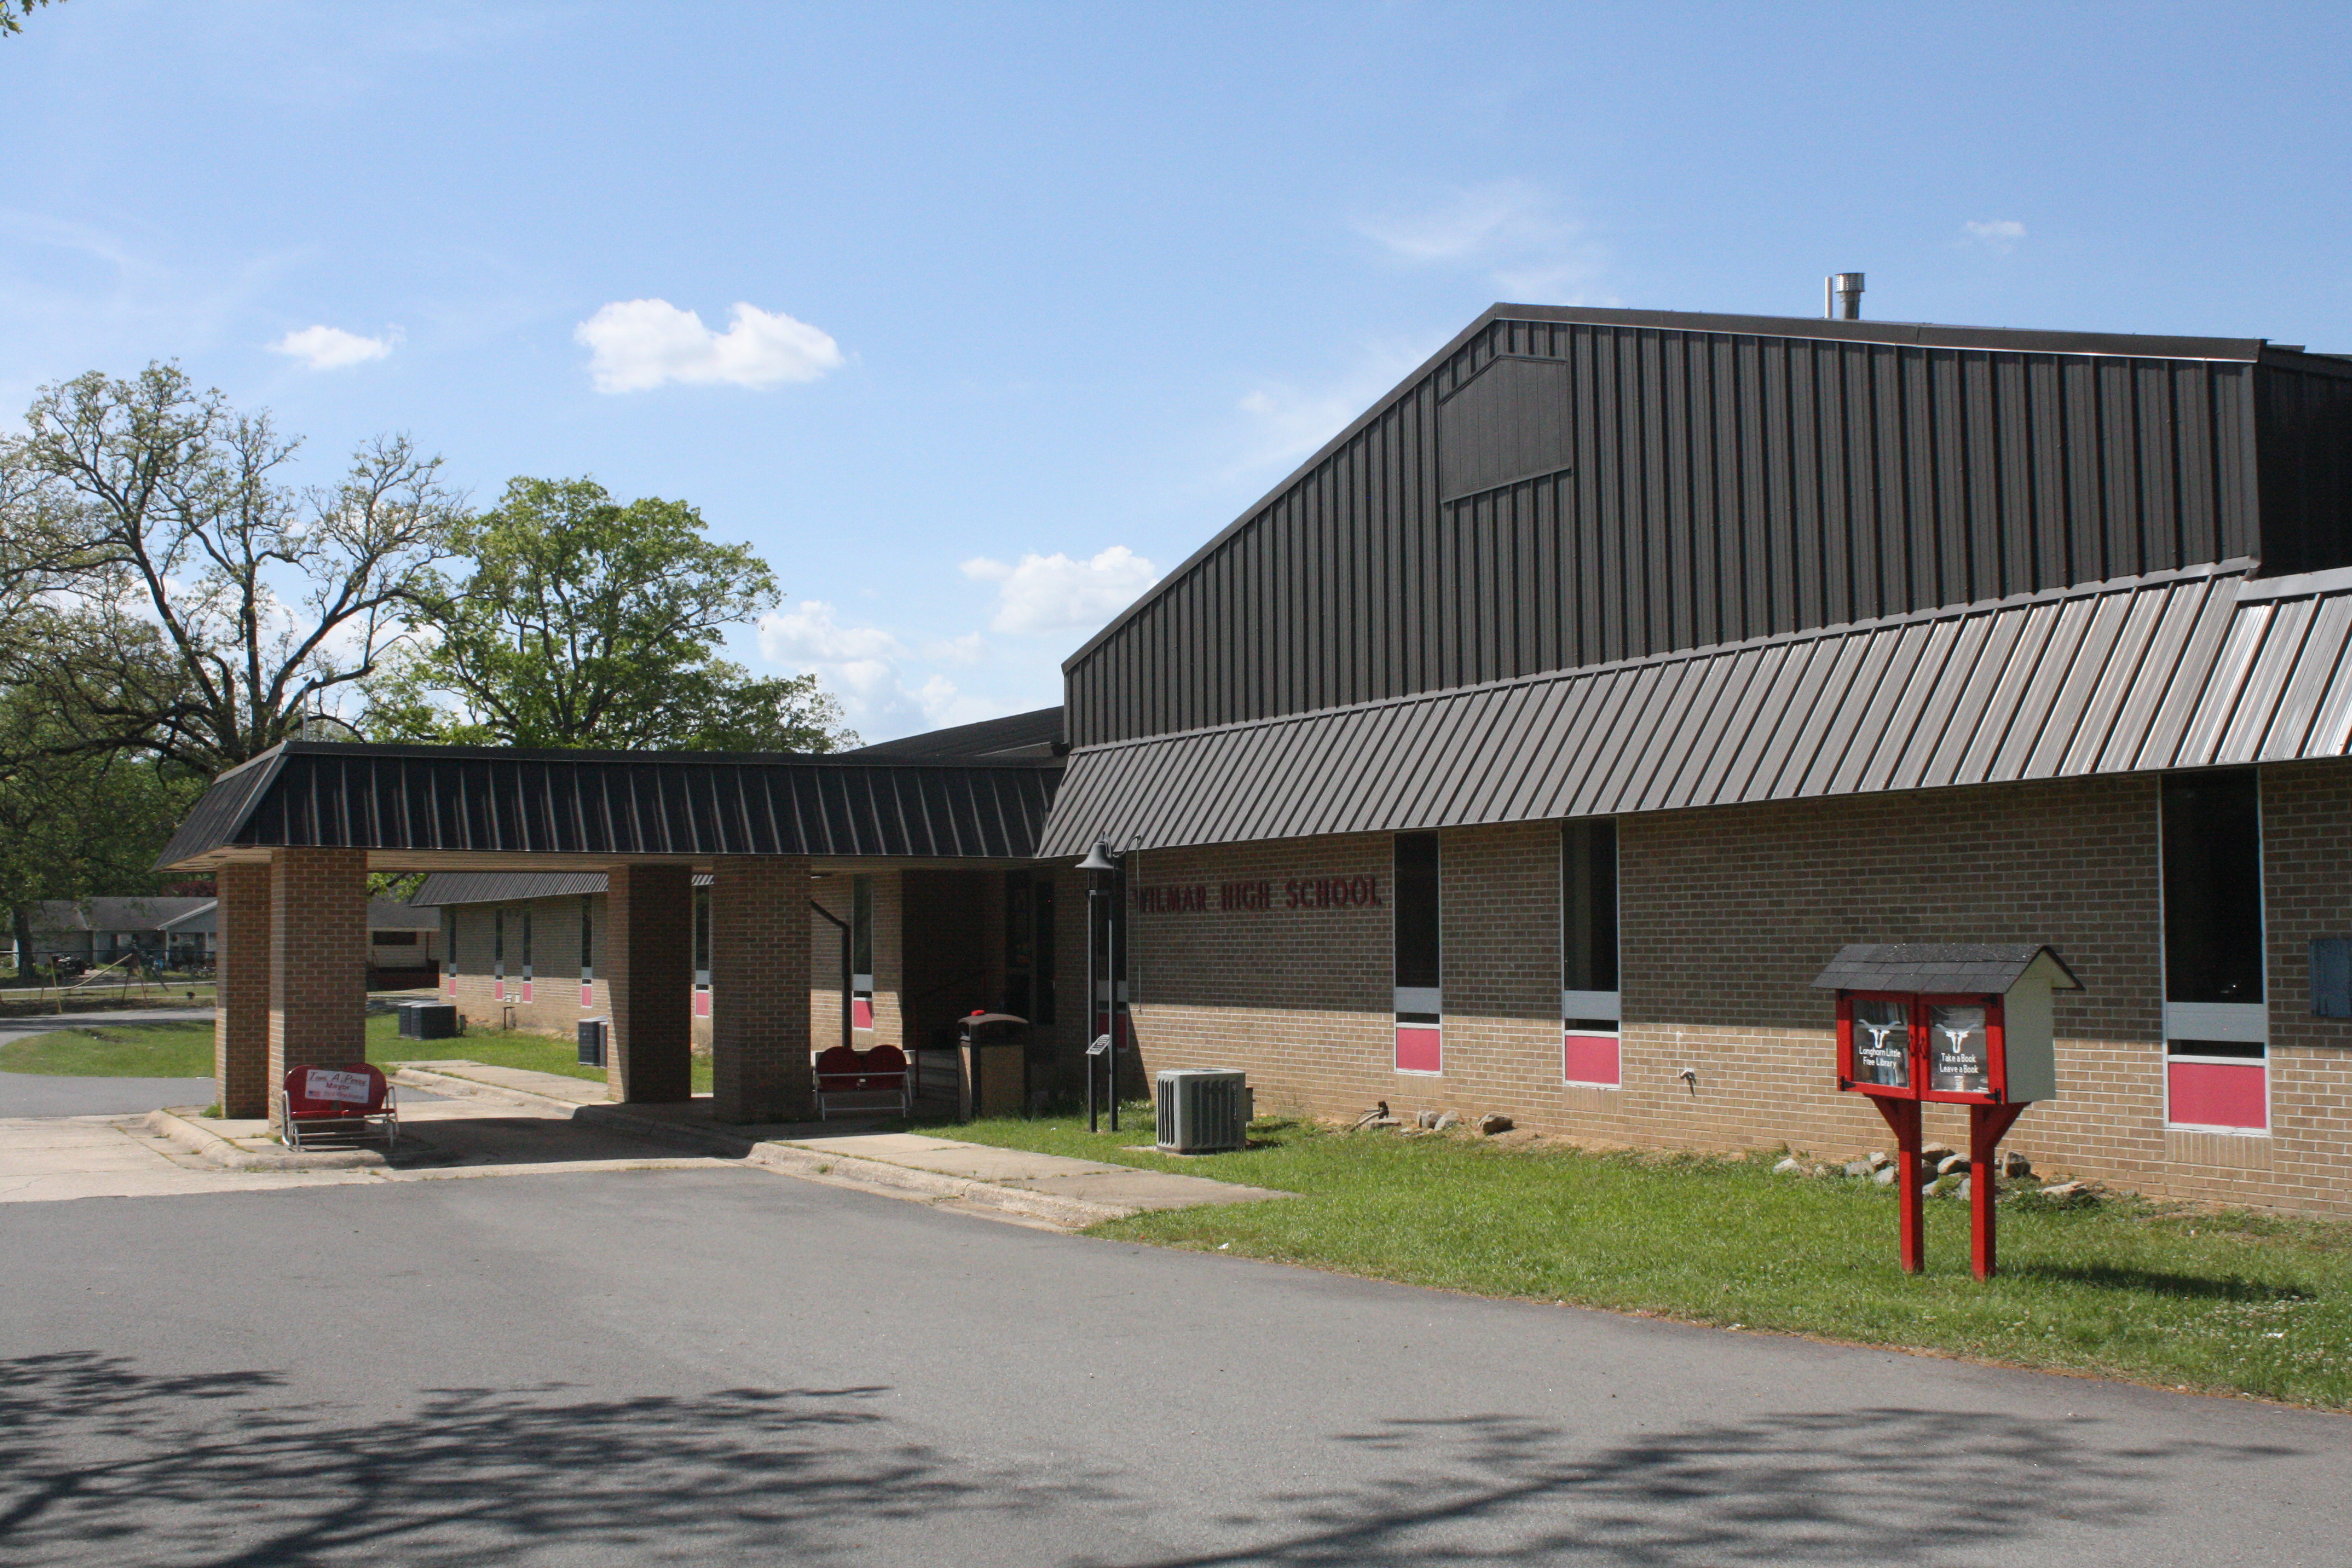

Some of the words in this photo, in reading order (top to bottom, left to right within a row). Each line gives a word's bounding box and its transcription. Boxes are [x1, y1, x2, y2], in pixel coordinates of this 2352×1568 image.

[1134, 884, 1207, 913] WILMAR
[1220, 880, 1270, 910] HIGH
[1285, 875, 1382, 908] SCHOOL
[1859, 1046, 1886, 1057] Longhorn
[1886, 1048, 1901, 1057] Little
[1863, 1056, 1875, 1065] Free
[1876, 1057, 1897, 1070] Library
[1941, 1053, 1956, 1062] Take
[1961, 1053, 1976, 1063] Book
[1939, 1063, 1958, 1073] Leave
[1963, 1064, 1979, 1074] Book
